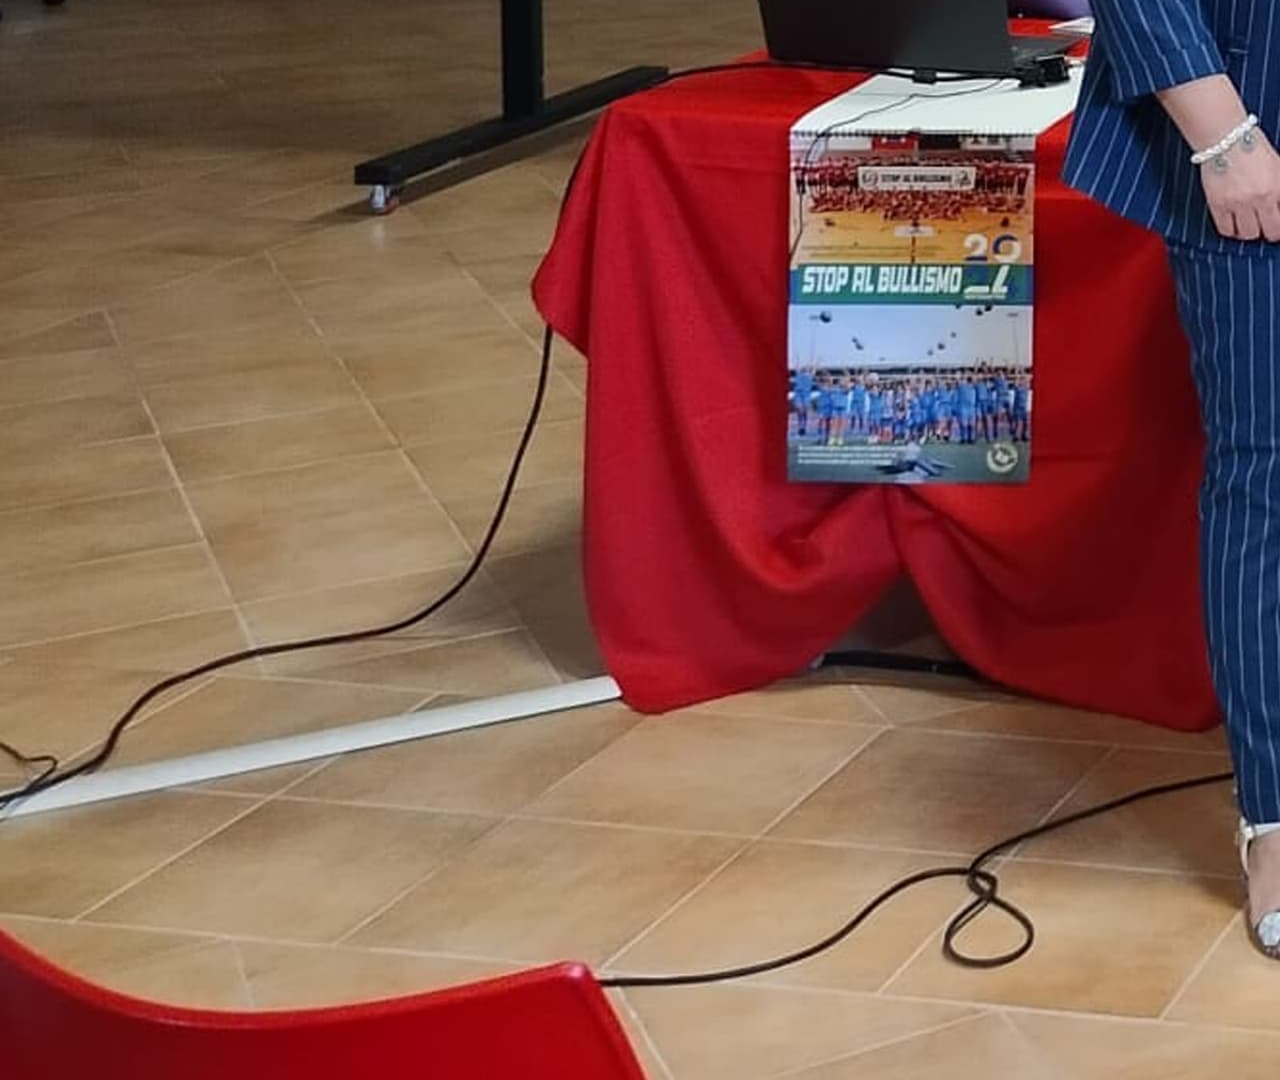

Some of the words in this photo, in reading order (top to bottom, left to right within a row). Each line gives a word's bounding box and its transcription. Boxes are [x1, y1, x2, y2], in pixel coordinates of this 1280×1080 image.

[802, 266, 849, 294] STOP
[852, 266, 874, 293] AL
[876, 266, 963, 294] BULLISMO
